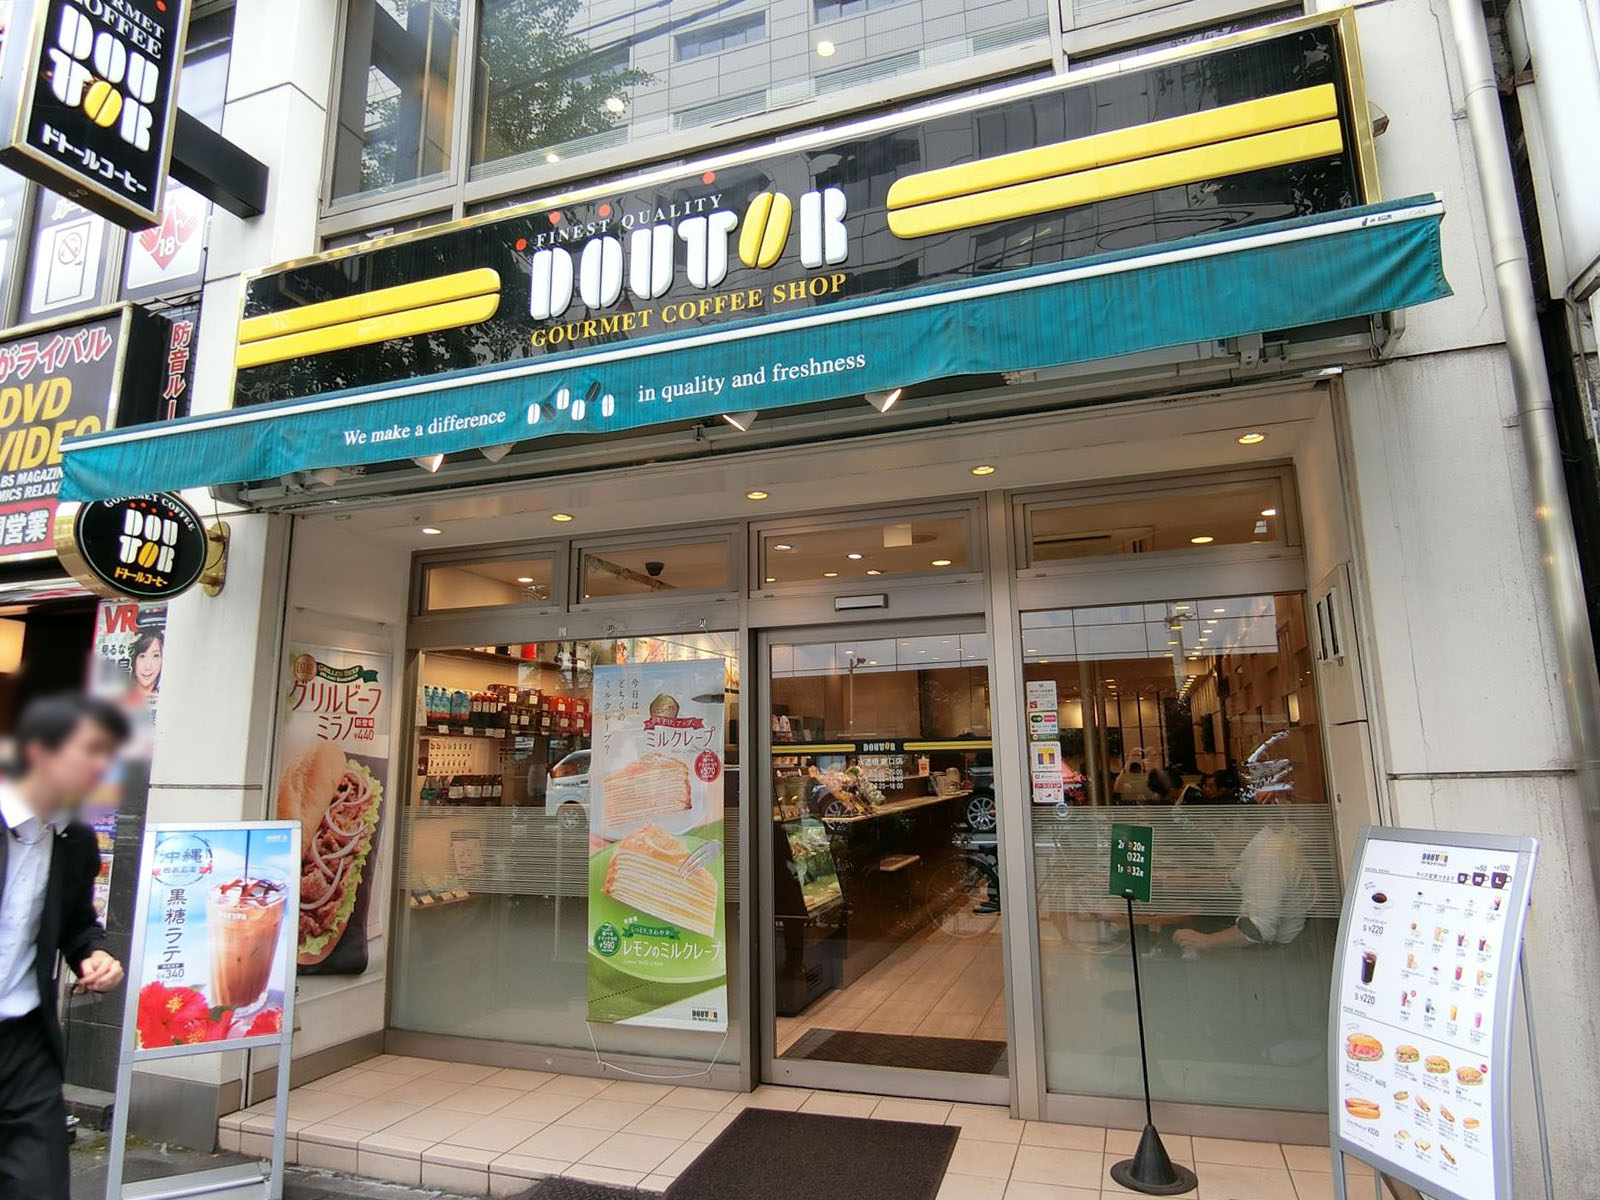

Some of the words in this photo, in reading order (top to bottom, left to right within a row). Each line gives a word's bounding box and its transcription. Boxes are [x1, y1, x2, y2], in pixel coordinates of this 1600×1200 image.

[42, 124, 148, 193] ドトールコーヒー
[537, 218, 611, 248] FINEST
[622, 193, 723, 228] QUALITY
[159, 237, 175, 257] 18
[530, 187, 849, 321] DOUTOR
[531, 309, 653, 349] GOURMET
[661, 288, 764, 325] COFFEE
[772, 273, 848, 304] SHOP
[0, 377, 72, 428] DVD
[344, 429, 366, 446] We
[370, 424, 411, 443] make
[414, 424, 424, 436] a
[428, 411, 506, 435] difference
[638, 385, 655, 403] in
[661, 375, 725, 403] quality
[732, 366, 766, 389] and
[772, 353, 866, 383] freshness
[161, 498, 196, 531] COFFEE
[114, 567, 168, 587] ドトールコーヒー
[104, 603, 139, 634] VR
[289, 680, 382, 714] グリルビーフ
[317, 716, 354, 741] ミラノ
[647, 726, 716, 748] ミルクレープ
[164, 888, 187, 963] 黒糖ラテ
